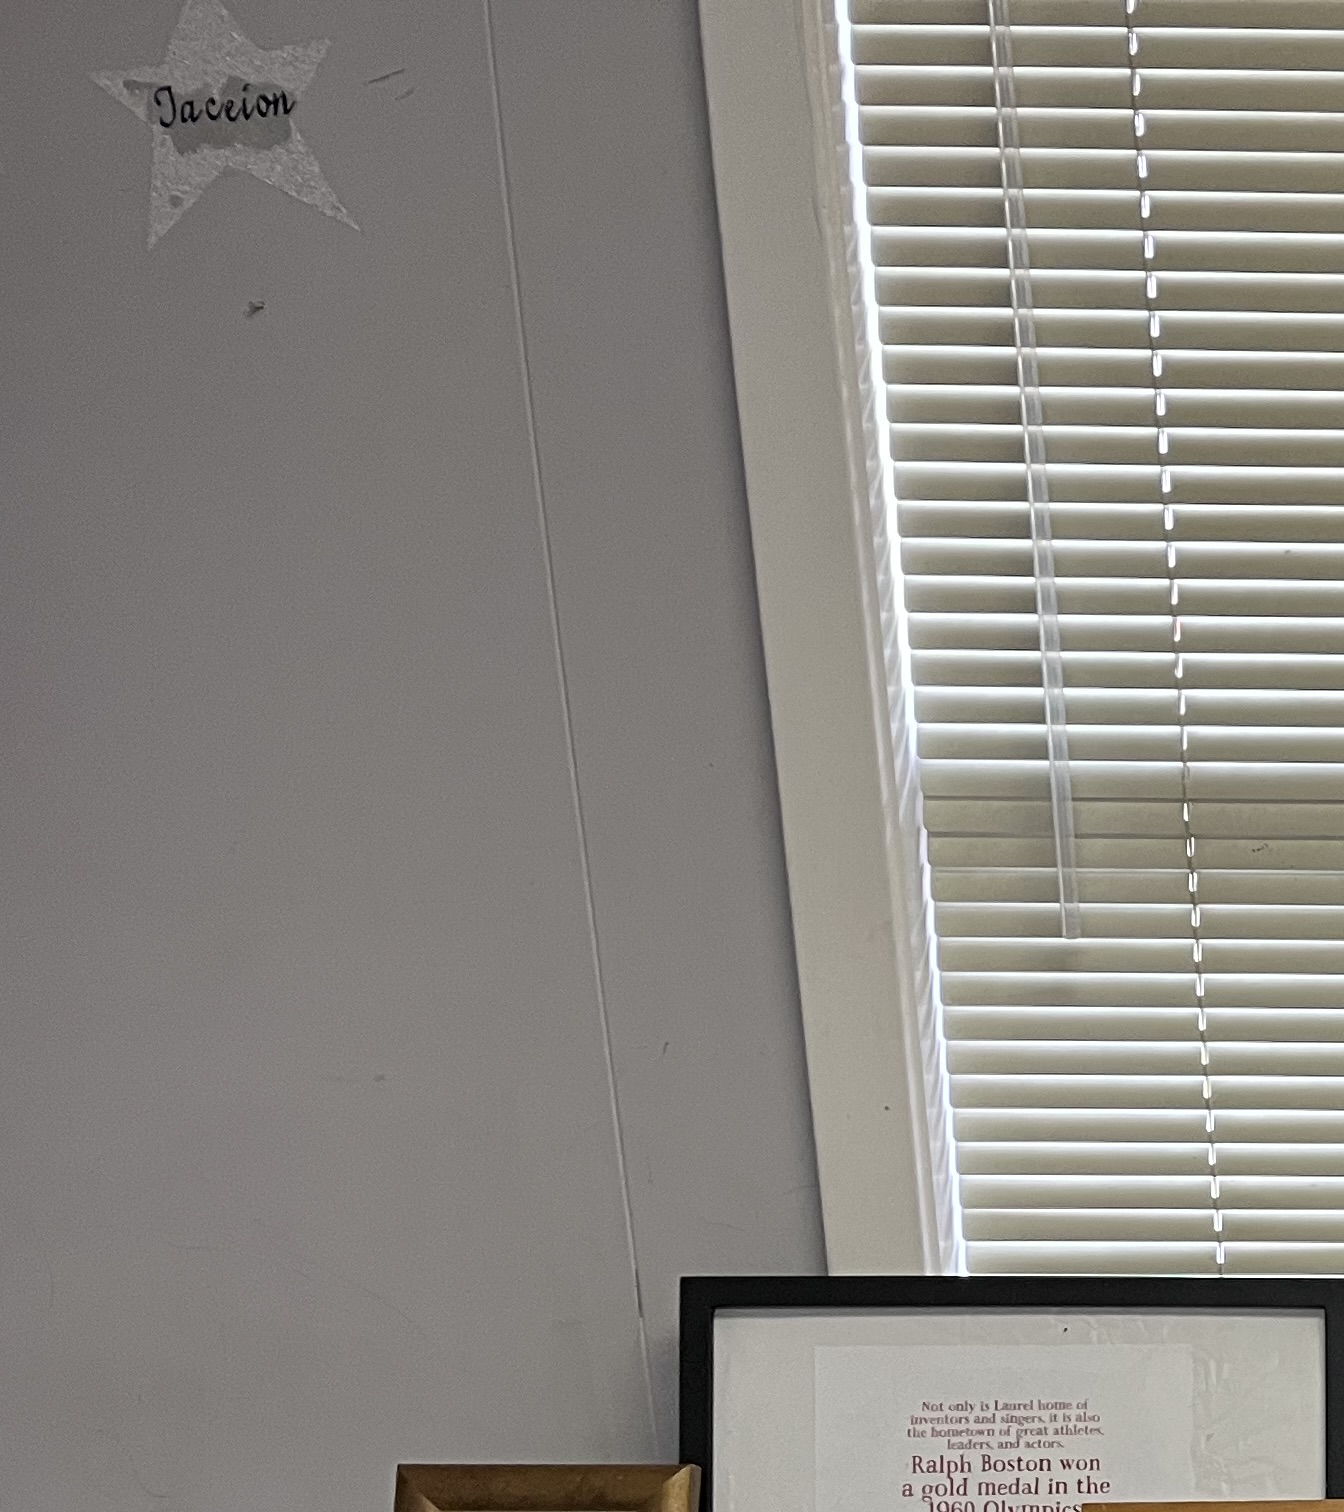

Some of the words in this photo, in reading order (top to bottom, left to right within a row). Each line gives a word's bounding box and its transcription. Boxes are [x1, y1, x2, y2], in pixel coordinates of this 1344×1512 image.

[921, 1400, 944, 1413] Not
[947, 1400, 975, 1415] only
[979, 1400, 991, 1412] is
[994, 1399, 1034, 1412] Laurel
[1038, 1399, 1073, 1411] home
[1076, 1398, 1090, 1411] of
[910, 1413, 970, 1426] inventors
[973, 1413, 996, 1425] and
[1049, 1412, 1059, 1424] it
[1062, 1412, 1073, 1424] is
[1075, 1411, 1101, 1424] also
[907, 1427, 928, 1439] the
[930, 1425, 996, 1438] hometown
[999, 1425, 1013, 1438] of
[1015, 1425, 1049, 1440] great
[997, 1437, 1021, 1450] and
[911, 1454, 973, 1478] Ralph
[981, 1453, 1052, 1473] Boston
[1058, 1457, 1102, 1472] won
[901, 1483, 914, 1497] a
[921, 1477, 969, 1503] gold
[976, 1476, 1040, 1497] medal
[1047, 1477, 1069, 1495] in
[1076, 1475, 1112, 1495] the
